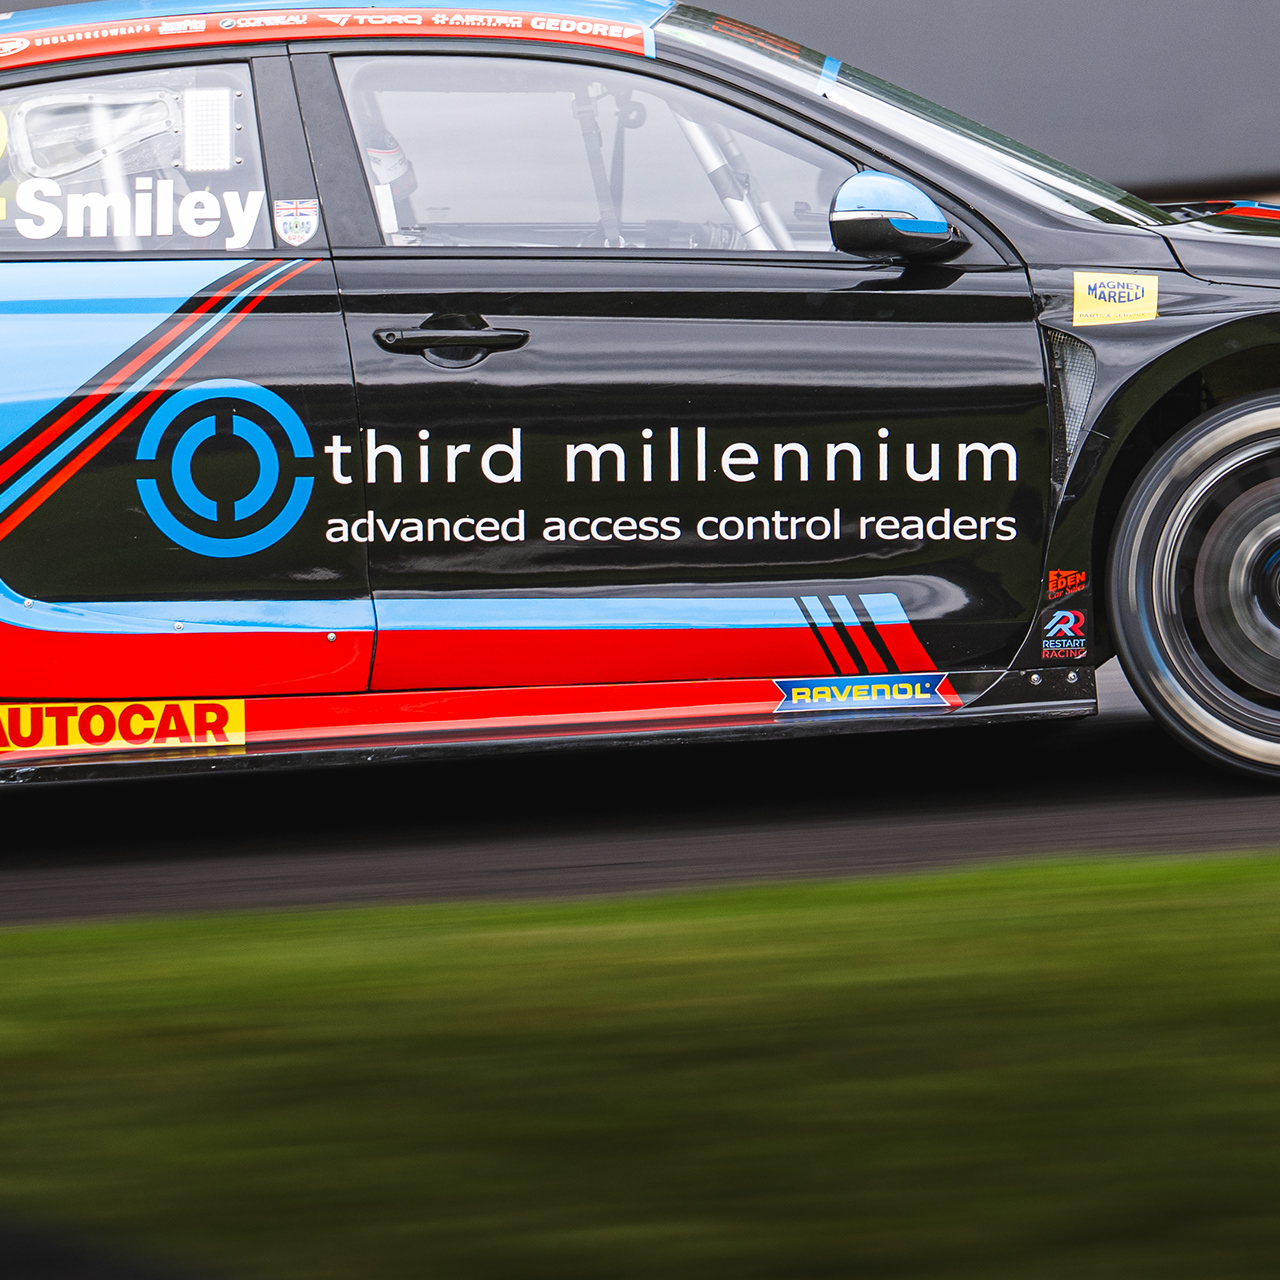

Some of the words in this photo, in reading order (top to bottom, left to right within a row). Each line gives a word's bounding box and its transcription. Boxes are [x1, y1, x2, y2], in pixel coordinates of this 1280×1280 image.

[353, 15, 423, 25] TORQ
[531, 17, 626, 38] GEDORE
[15, 176, 266, 252] Smiley
[1087, 280, 1145, 293] MAGNETI
[1087, 287, 1145, 304] MARELLI
[324, 428, 522, 484] third
[566, 427, 1018, 484] millennium
[325, 509, 525, 544] advanced
[542, 516, 681, 542] access
[696, 508, 839, 542] control
[858, 508, 1017, 542] readers
[1048, 571, 1086, 591] EDEN
[1047, 590, 1064, 600] Car
[1042, 639, 1086, 648] RESTART
[1042, 649, 1087, 659] RACING
[791, 683, 931, 704] RAVENOL
